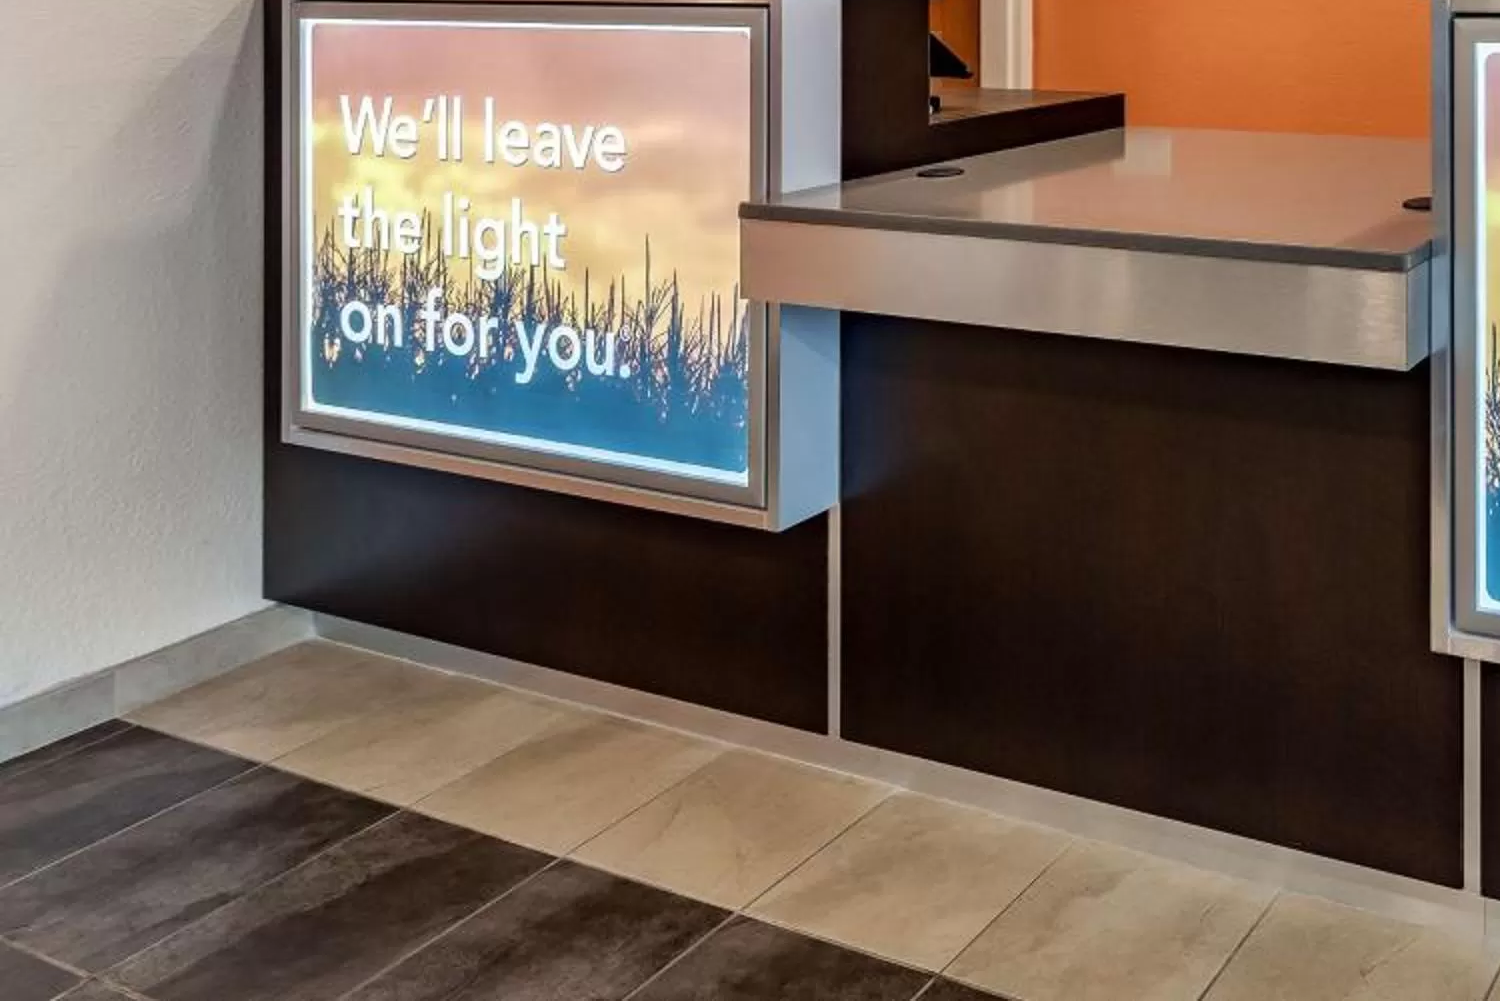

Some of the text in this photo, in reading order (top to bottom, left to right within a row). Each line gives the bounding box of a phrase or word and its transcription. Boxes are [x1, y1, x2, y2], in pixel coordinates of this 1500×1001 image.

[340, 95, 629, 173] We'll leave
[338, 186, 568, 280] the light
[340, 287, 631, 383] on for you.
